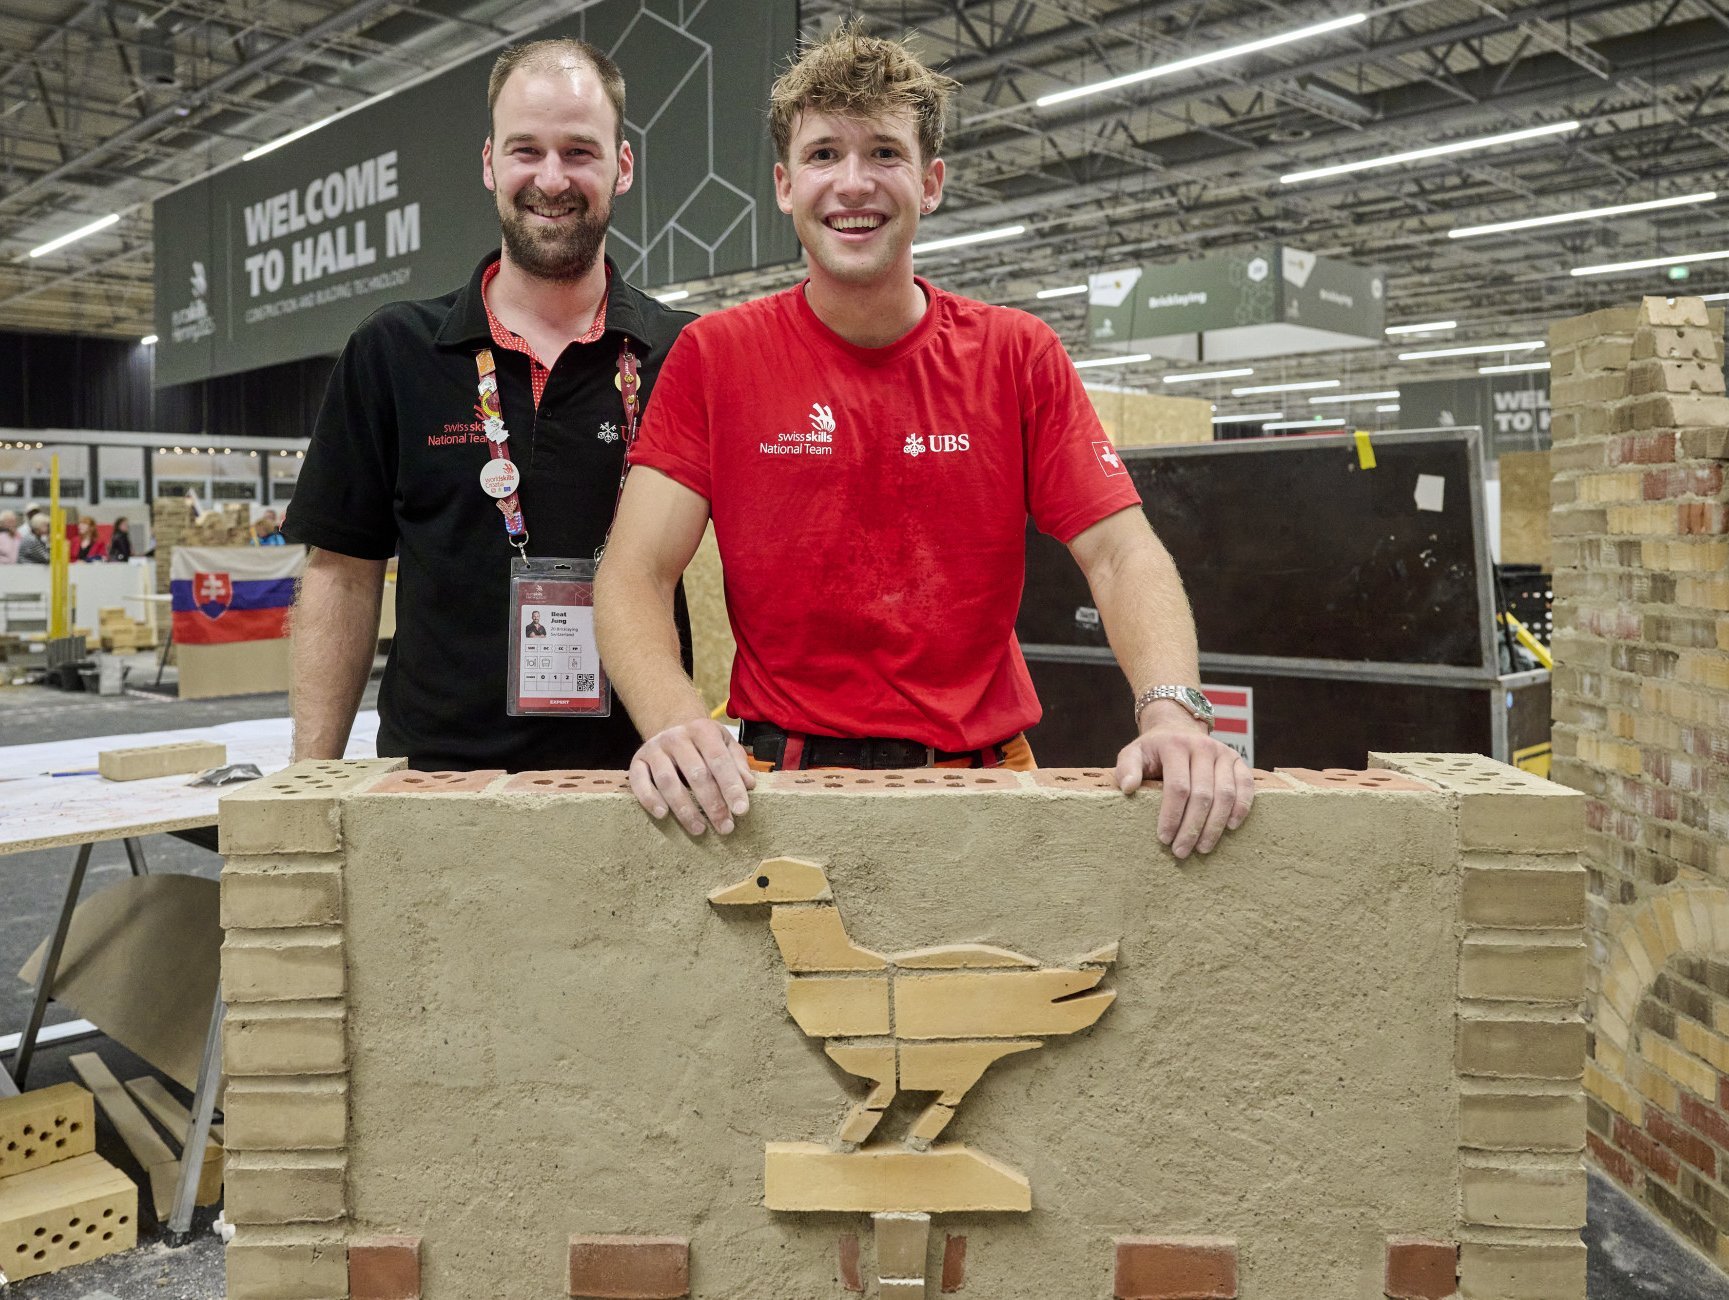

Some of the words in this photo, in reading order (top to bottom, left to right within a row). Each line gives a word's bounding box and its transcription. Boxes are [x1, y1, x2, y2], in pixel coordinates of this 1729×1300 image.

[244, 150, 398, 246] WELCOME
[244, 248, 285, 297] TO
[292, 220, 376, 285] HALL
[385, 202, 421, 258] M
[1493, 411, 1533, 432] TO
[428, 433, 467, 446] National
[759, 442, 803, 455] National
[803, 444, 832, 455] Team
[928, 434, 970, 453] UBS
